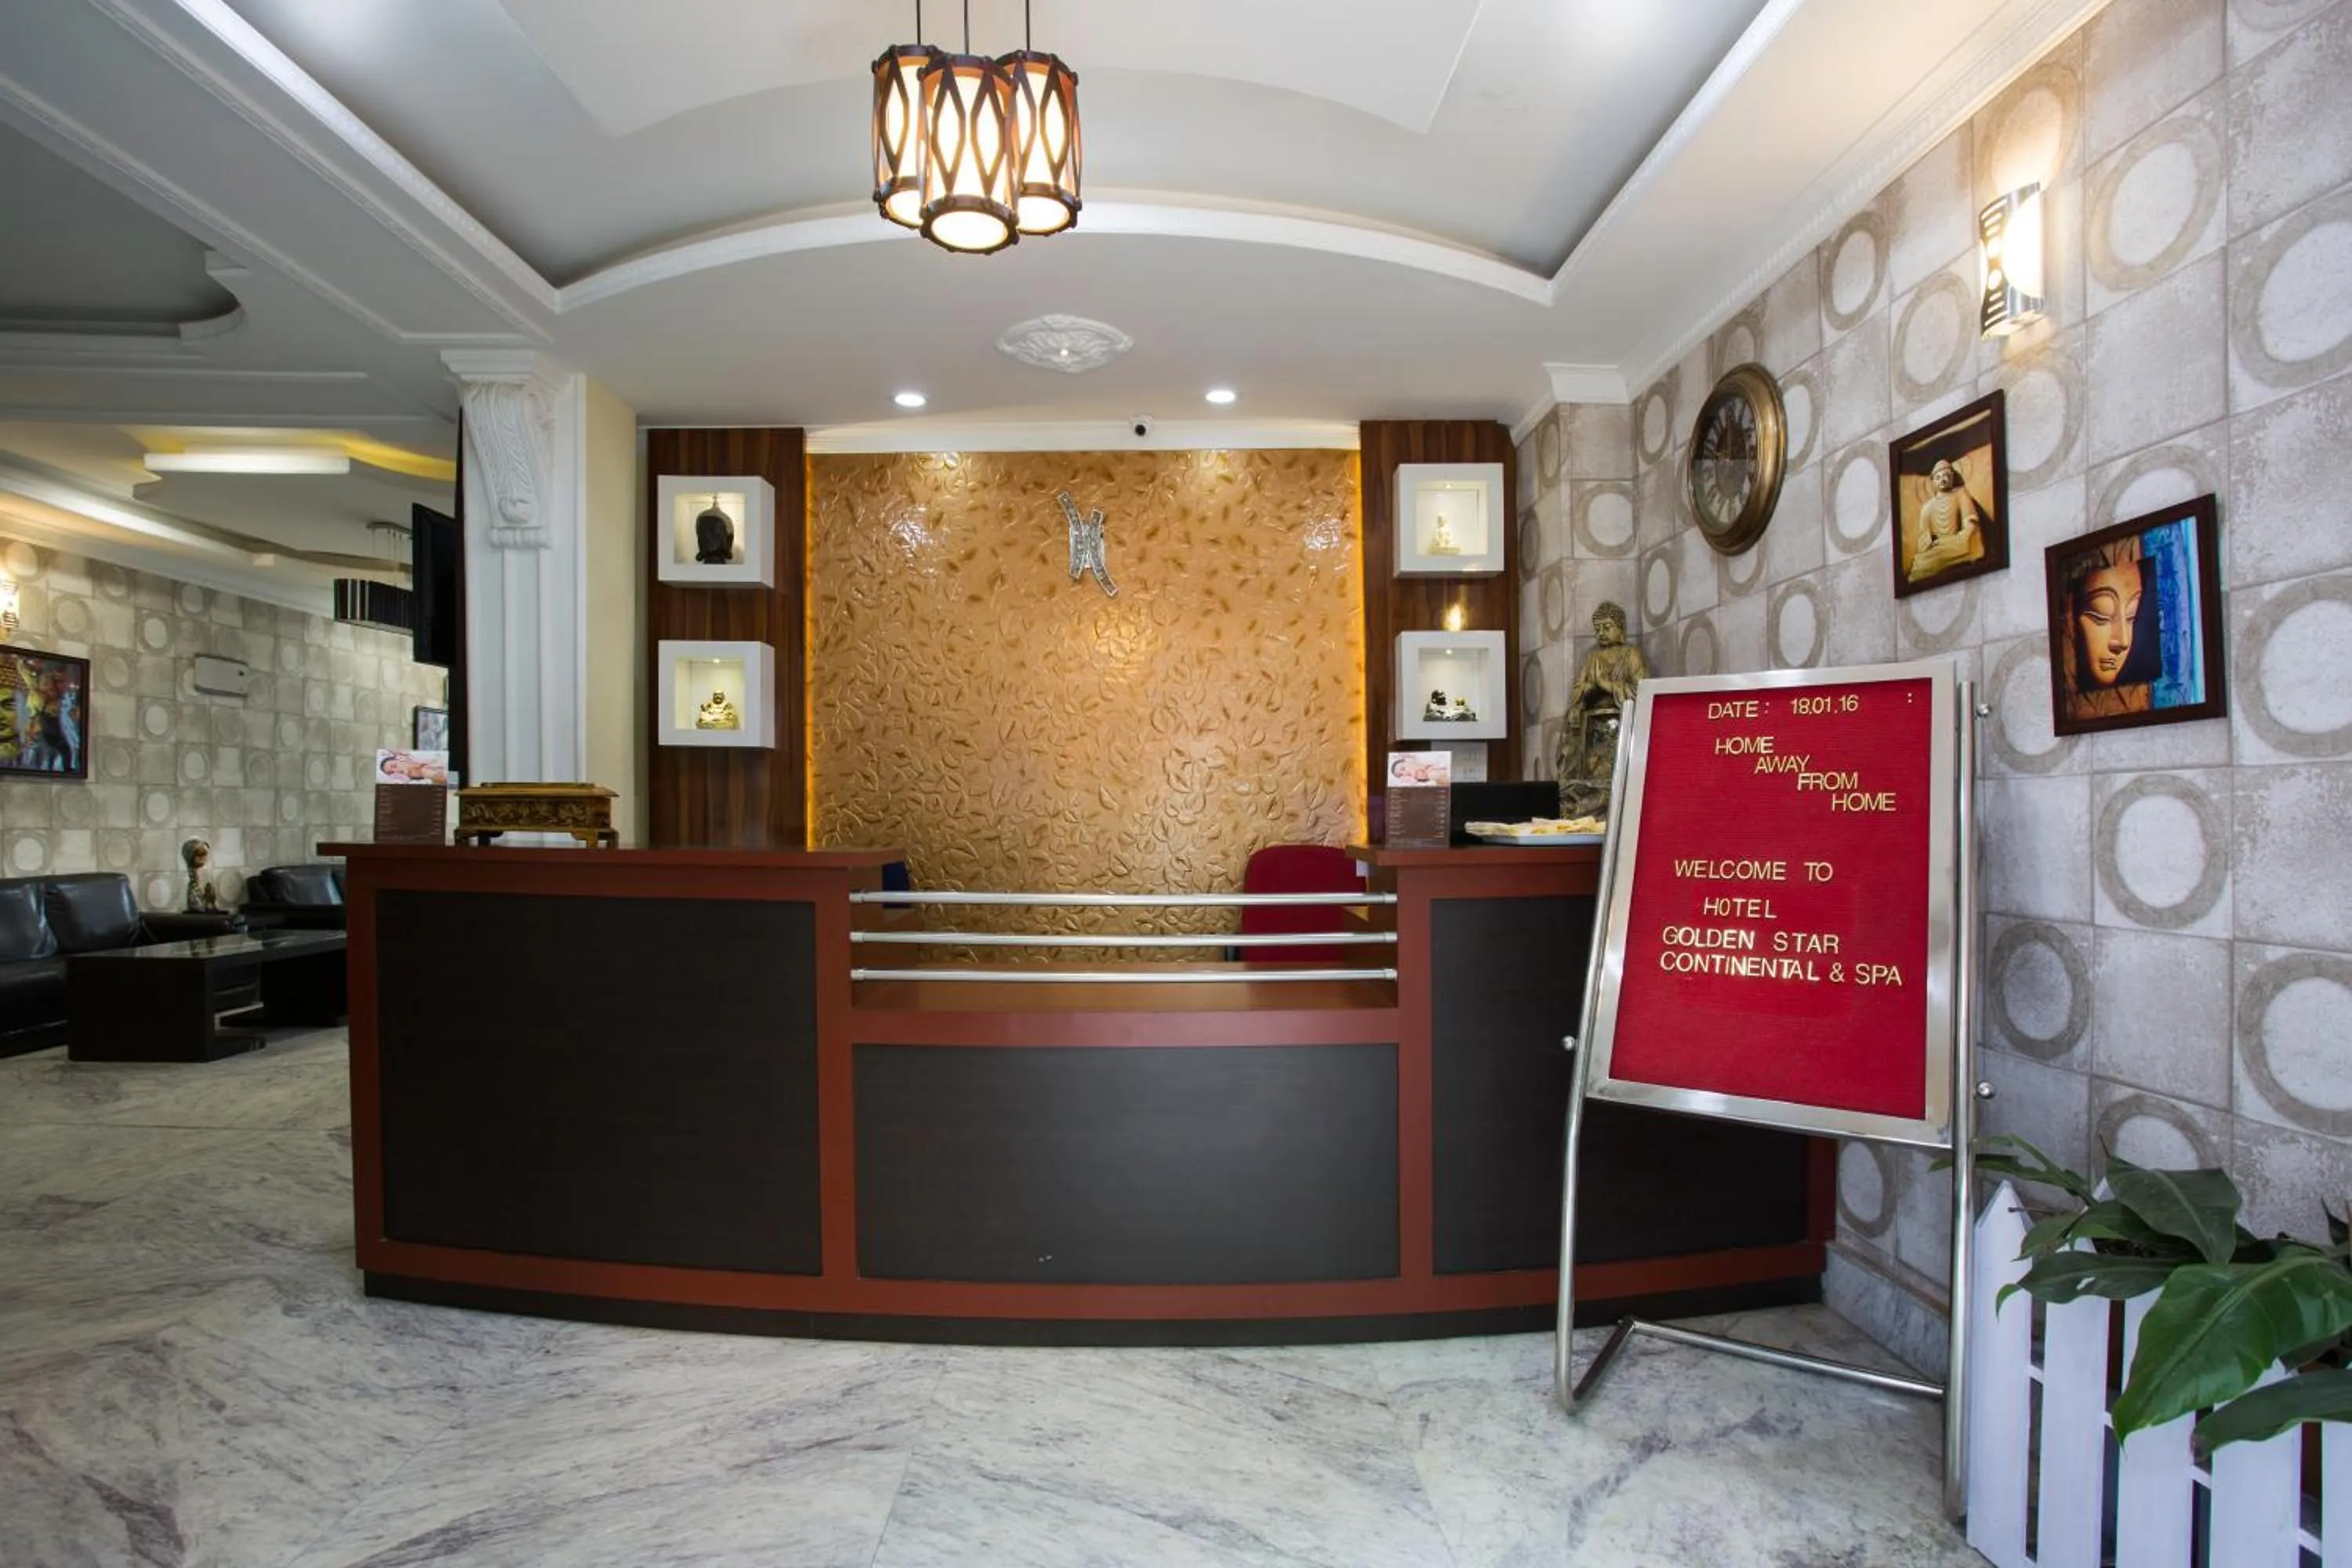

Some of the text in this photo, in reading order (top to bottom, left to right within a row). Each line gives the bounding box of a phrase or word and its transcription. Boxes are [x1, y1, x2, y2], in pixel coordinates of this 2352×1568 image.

[1715, 735, 1774, 755] HOME
[1754, 754, 1810, 775] AWAY
[1797, 771, 1859, 791] FROM
[1831, 792, 1896, 811] HOME
[1675, 859, 1833, 882] WELCOME TO
[1703, 896, 1777, 919] HOTEL
[1662, 925, 1840, 954] GOLDEN STAR
[1660, 950, 1903, 986] CONTINENTAL & SPA
